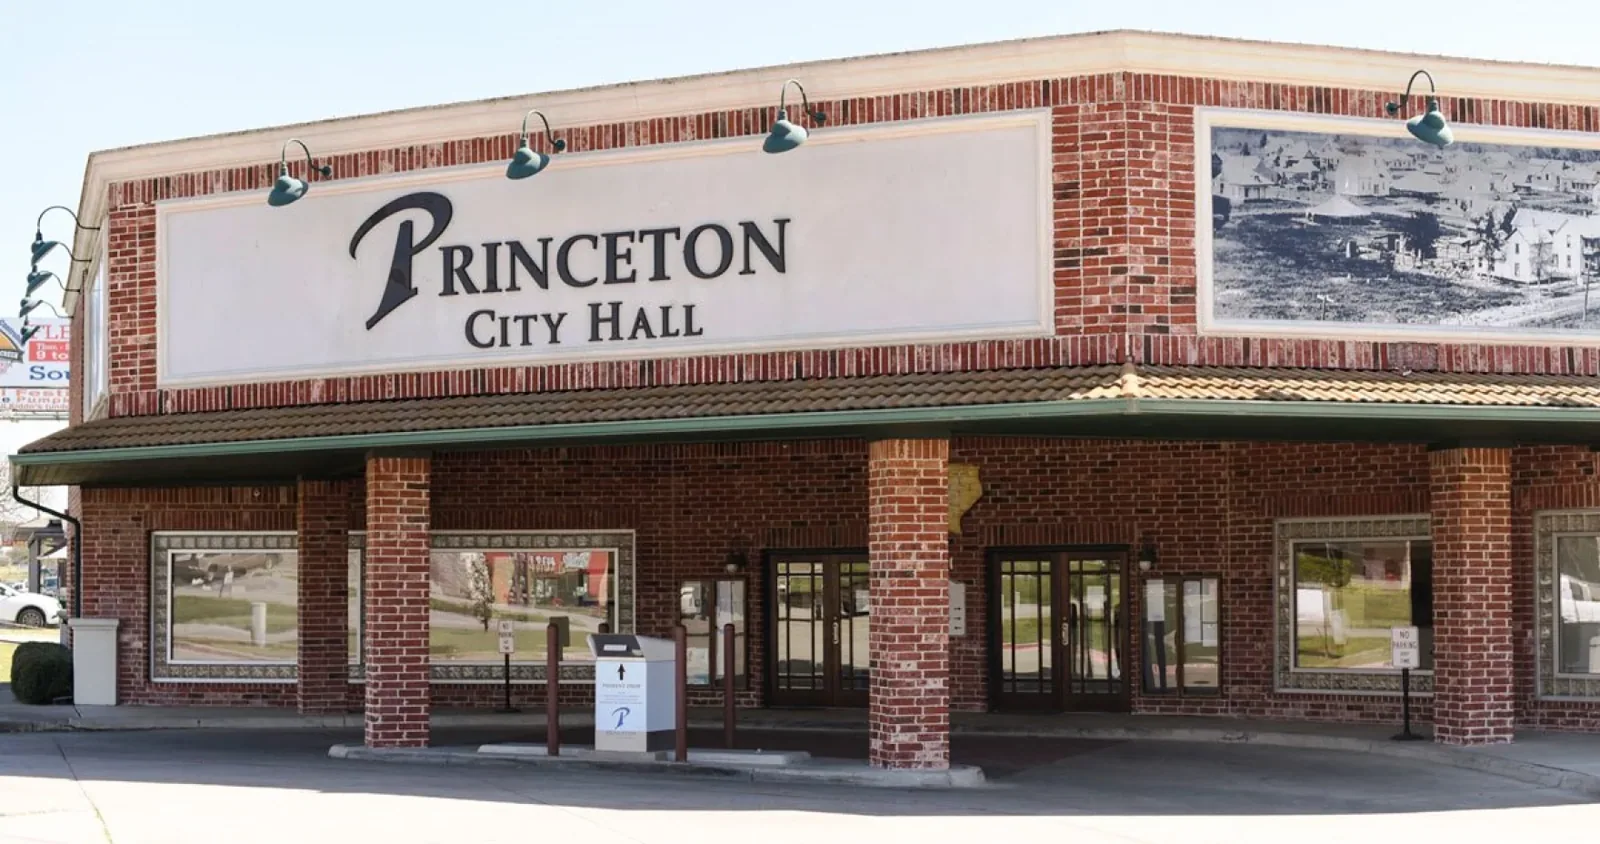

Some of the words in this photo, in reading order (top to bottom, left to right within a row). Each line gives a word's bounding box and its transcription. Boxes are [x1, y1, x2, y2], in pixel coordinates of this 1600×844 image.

[349, 191, 791, 330] PRINCETON
[465, 309, 568, 349] CITY
[588, 301, 703, 342] HALL
[1392, 640, 1418, 650] PARKING
[1400, 630, 1410, 640] NO
